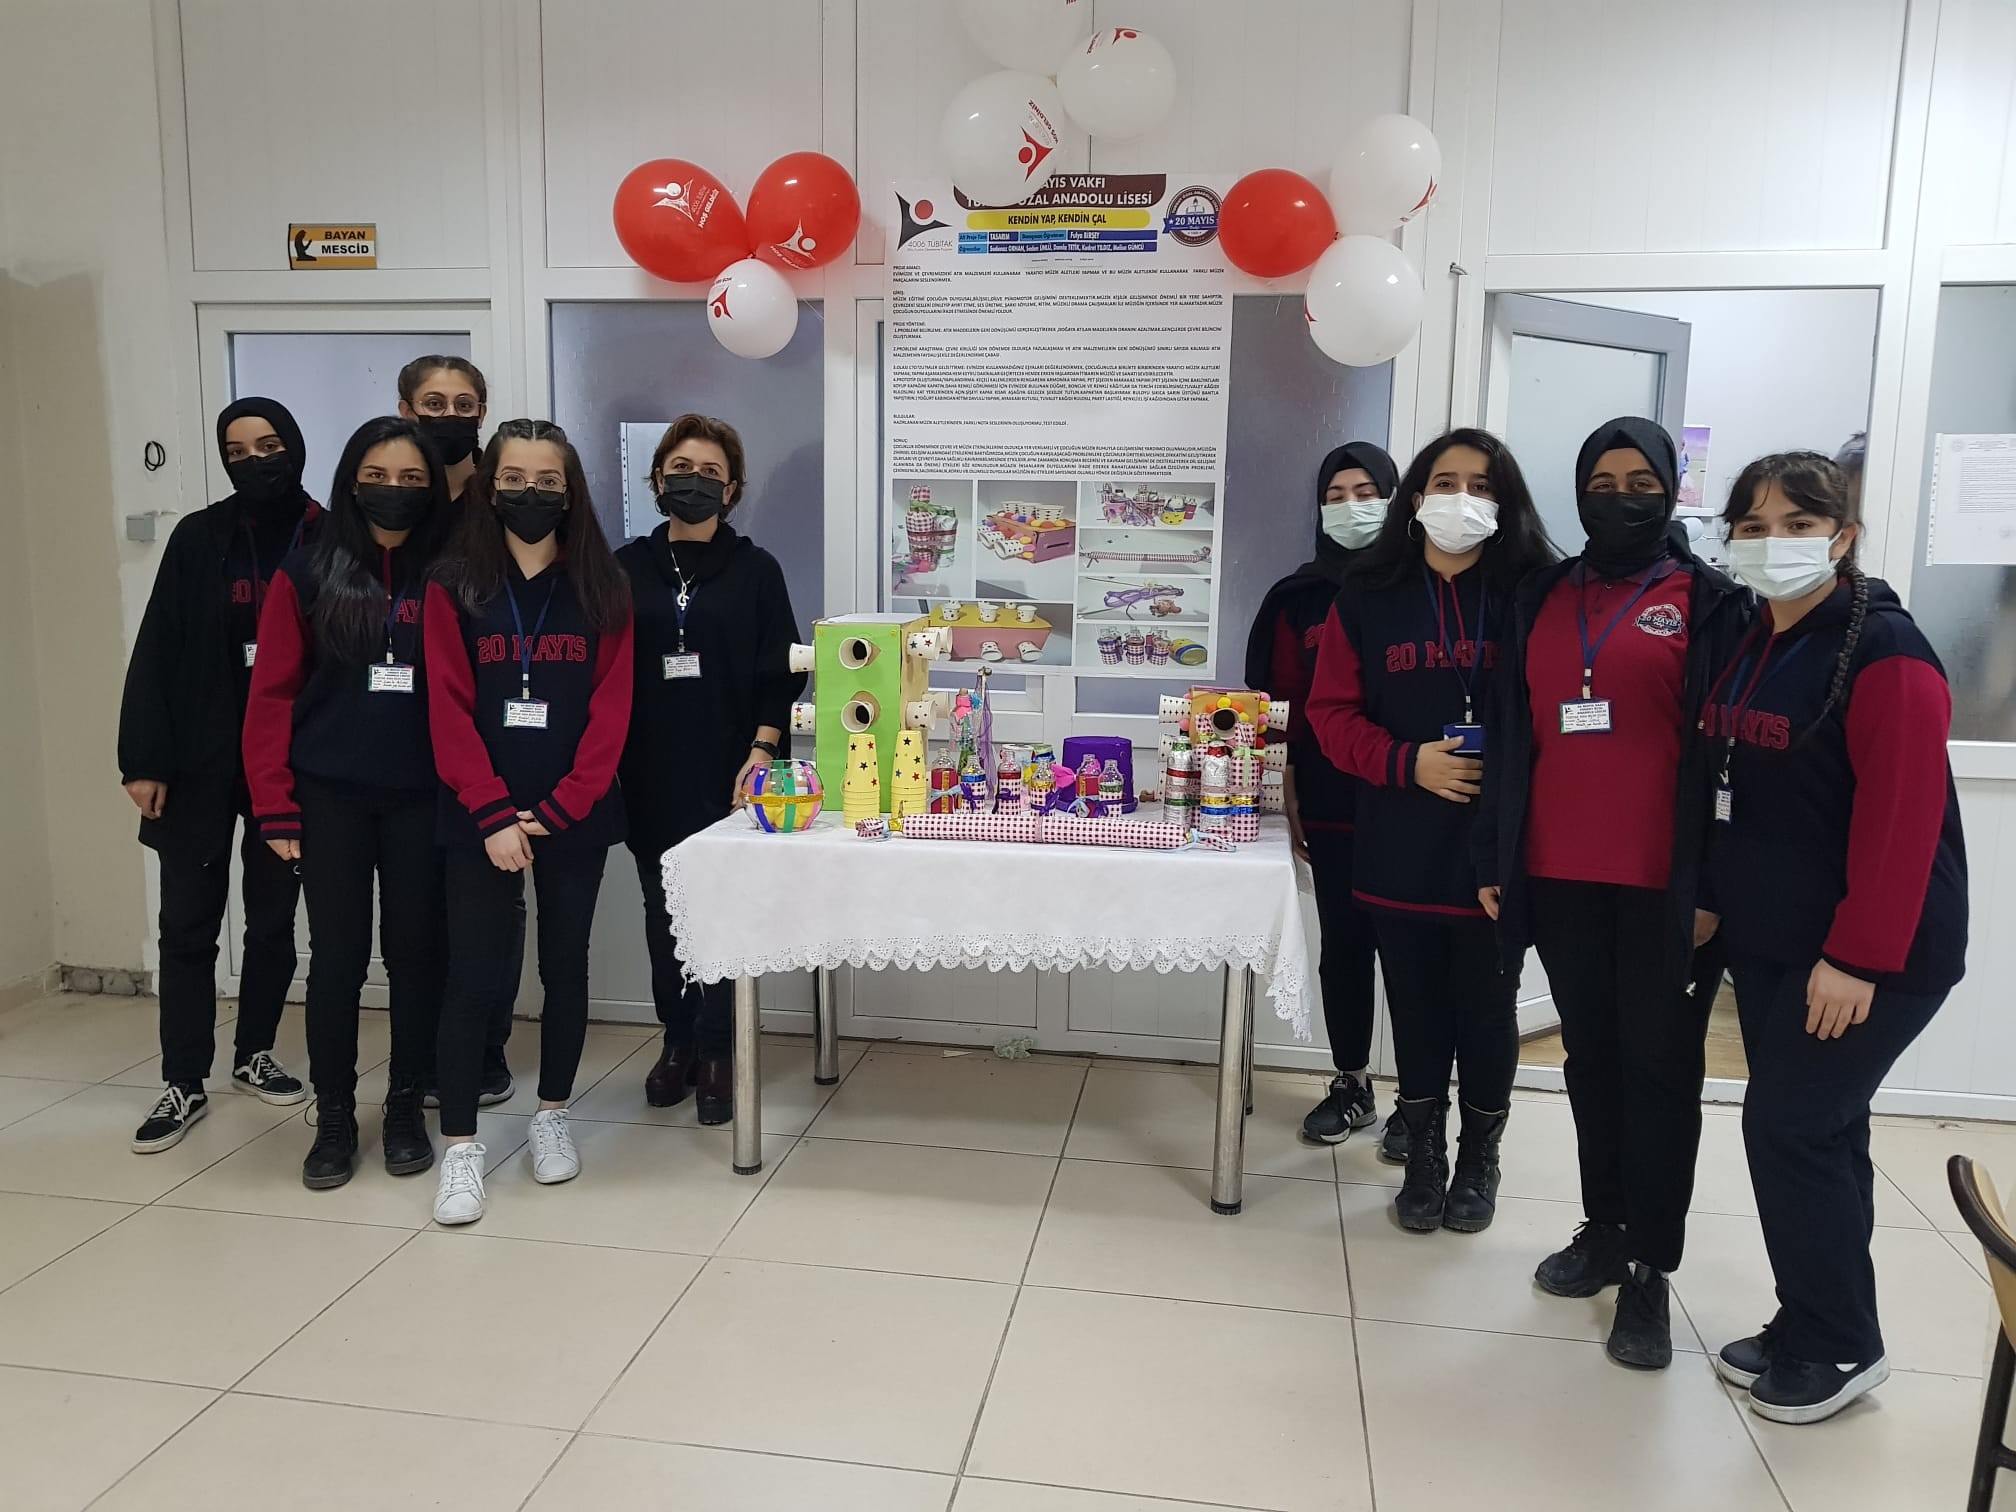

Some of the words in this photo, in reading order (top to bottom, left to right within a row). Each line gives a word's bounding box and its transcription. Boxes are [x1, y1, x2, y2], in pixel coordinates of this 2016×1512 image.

[1043, 177, 1066, 189] AYIS
[1070, 177, 1106, 189] VAKFI
[1052, 193, 1114, 205] ANADOLU
[1117, 190, 1153, 205] LİSESİ
[1008, 213, 1039, 225] KENDİN
[1041, 214, 1057, 226] YAP,
[1058, 211, 1090, 224] KENDİN
[1092, 213, 1107, 226] ÇAL
[1175, 217, 1186, 226] 20
[1187, 215, 1215, 226] MAYIS
[324, 230, 366, 241] BAYAN
[321, 242, 369, 255] MESCİD
[907, 240, 926, 248] 4006
[477, 634, 506, 664] 20
[511, 634, 587, 662] MAYIS
[1386, 642, 1417, 673] 20
